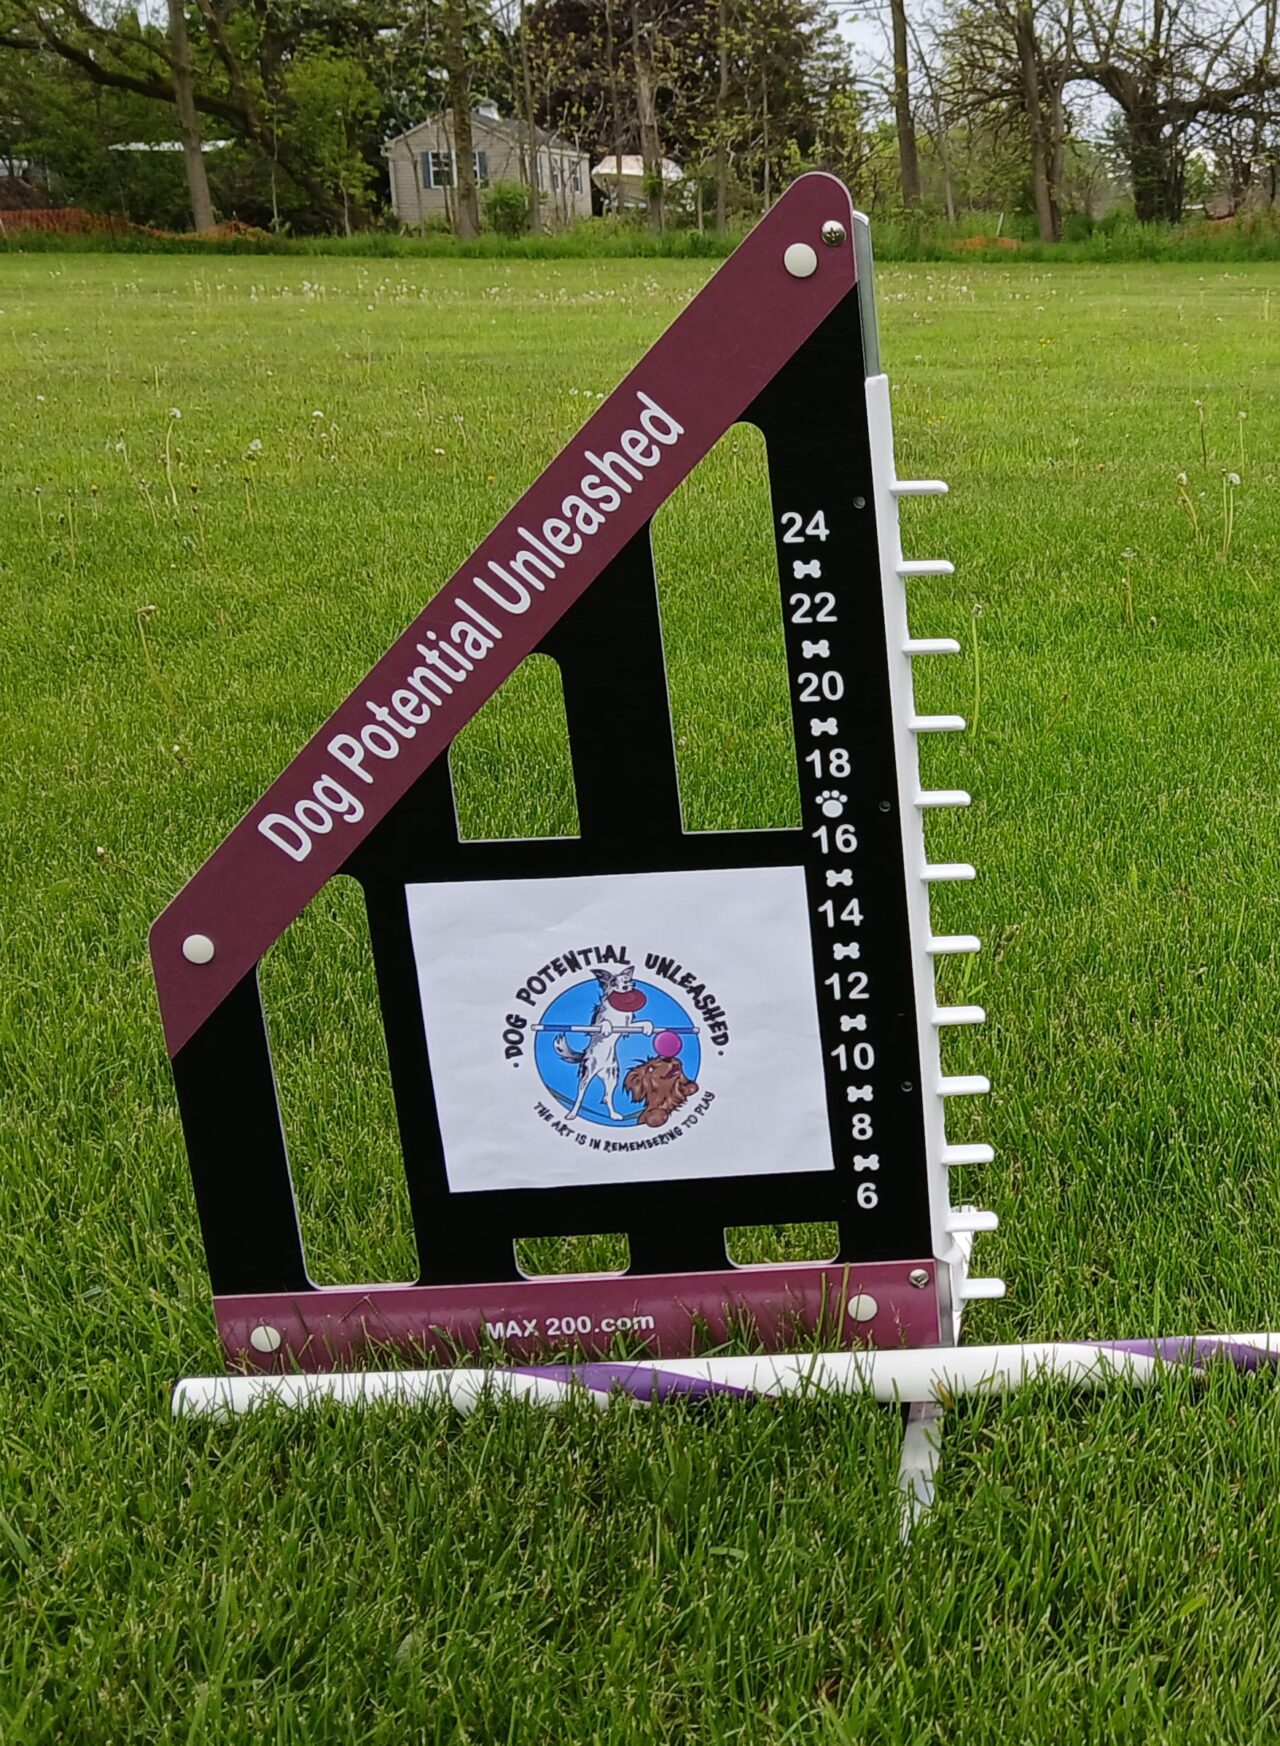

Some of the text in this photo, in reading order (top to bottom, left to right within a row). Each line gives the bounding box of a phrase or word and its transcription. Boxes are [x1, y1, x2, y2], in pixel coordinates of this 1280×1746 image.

[781, 511, 829, 543] 24
[790, 592, 837, 623] 22
[257, 390, 684, 862] Dog Potential Unleashed
[798, 671, 843, 702] 20
[806, 749, 850, 778] 18
[813, 824, 857, 853] 16
[818, 898, 863, 927] 14
[825, 972, 869, 1000] 12
[503, 945, 729, 1059] DOG POTENTIAL UNLEASHED
[831, 1043, 874, 1071] 10
[533, 1091, 716, 1153] THE ART IS IN REMEMBERING TO PLAY
[852, 1114, 872, 1140] 8
[857, 1183, 878, 1208] 6
[485, 1315, 654, 1339] MAX 200.com
